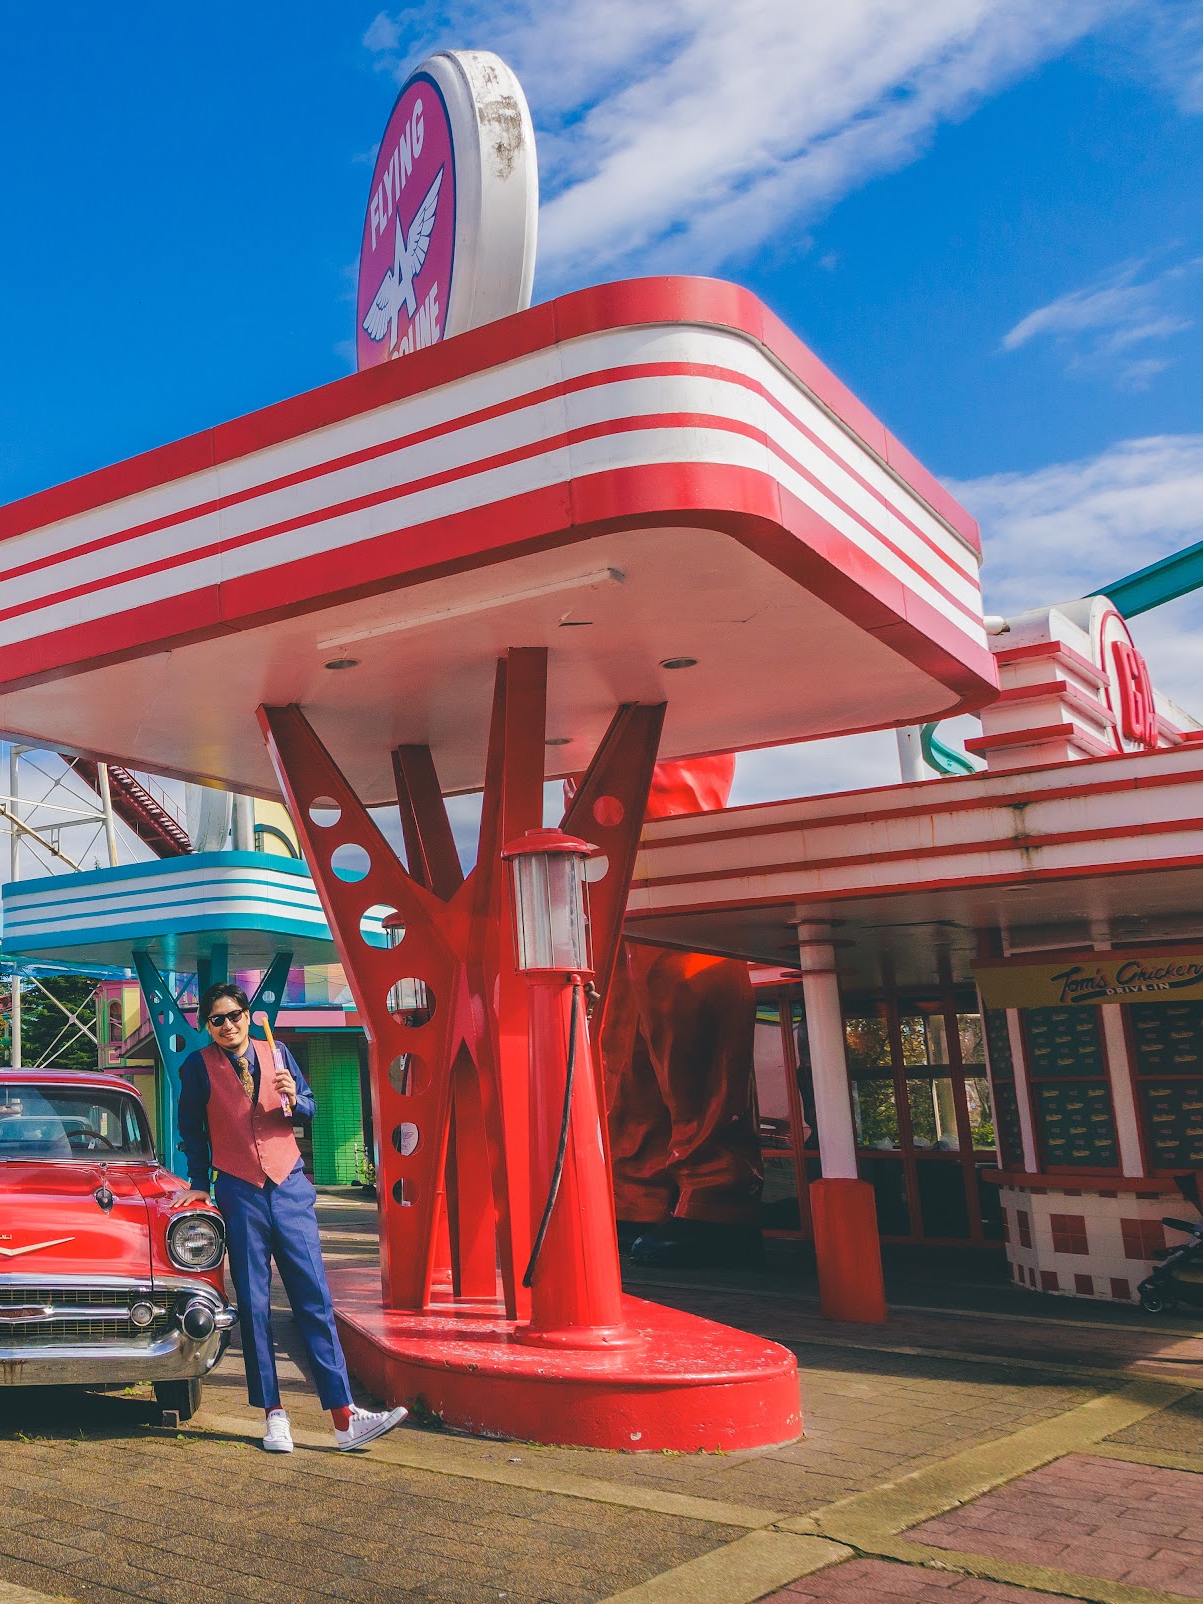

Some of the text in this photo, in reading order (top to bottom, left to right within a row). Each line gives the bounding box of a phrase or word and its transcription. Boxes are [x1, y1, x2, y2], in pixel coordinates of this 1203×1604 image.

[370, 98, 424, 252] FLYING
[1050, 960, 1203, 1003] Tom's Chicken
[1105, 982, 1171, 996] DRIVE-IN
